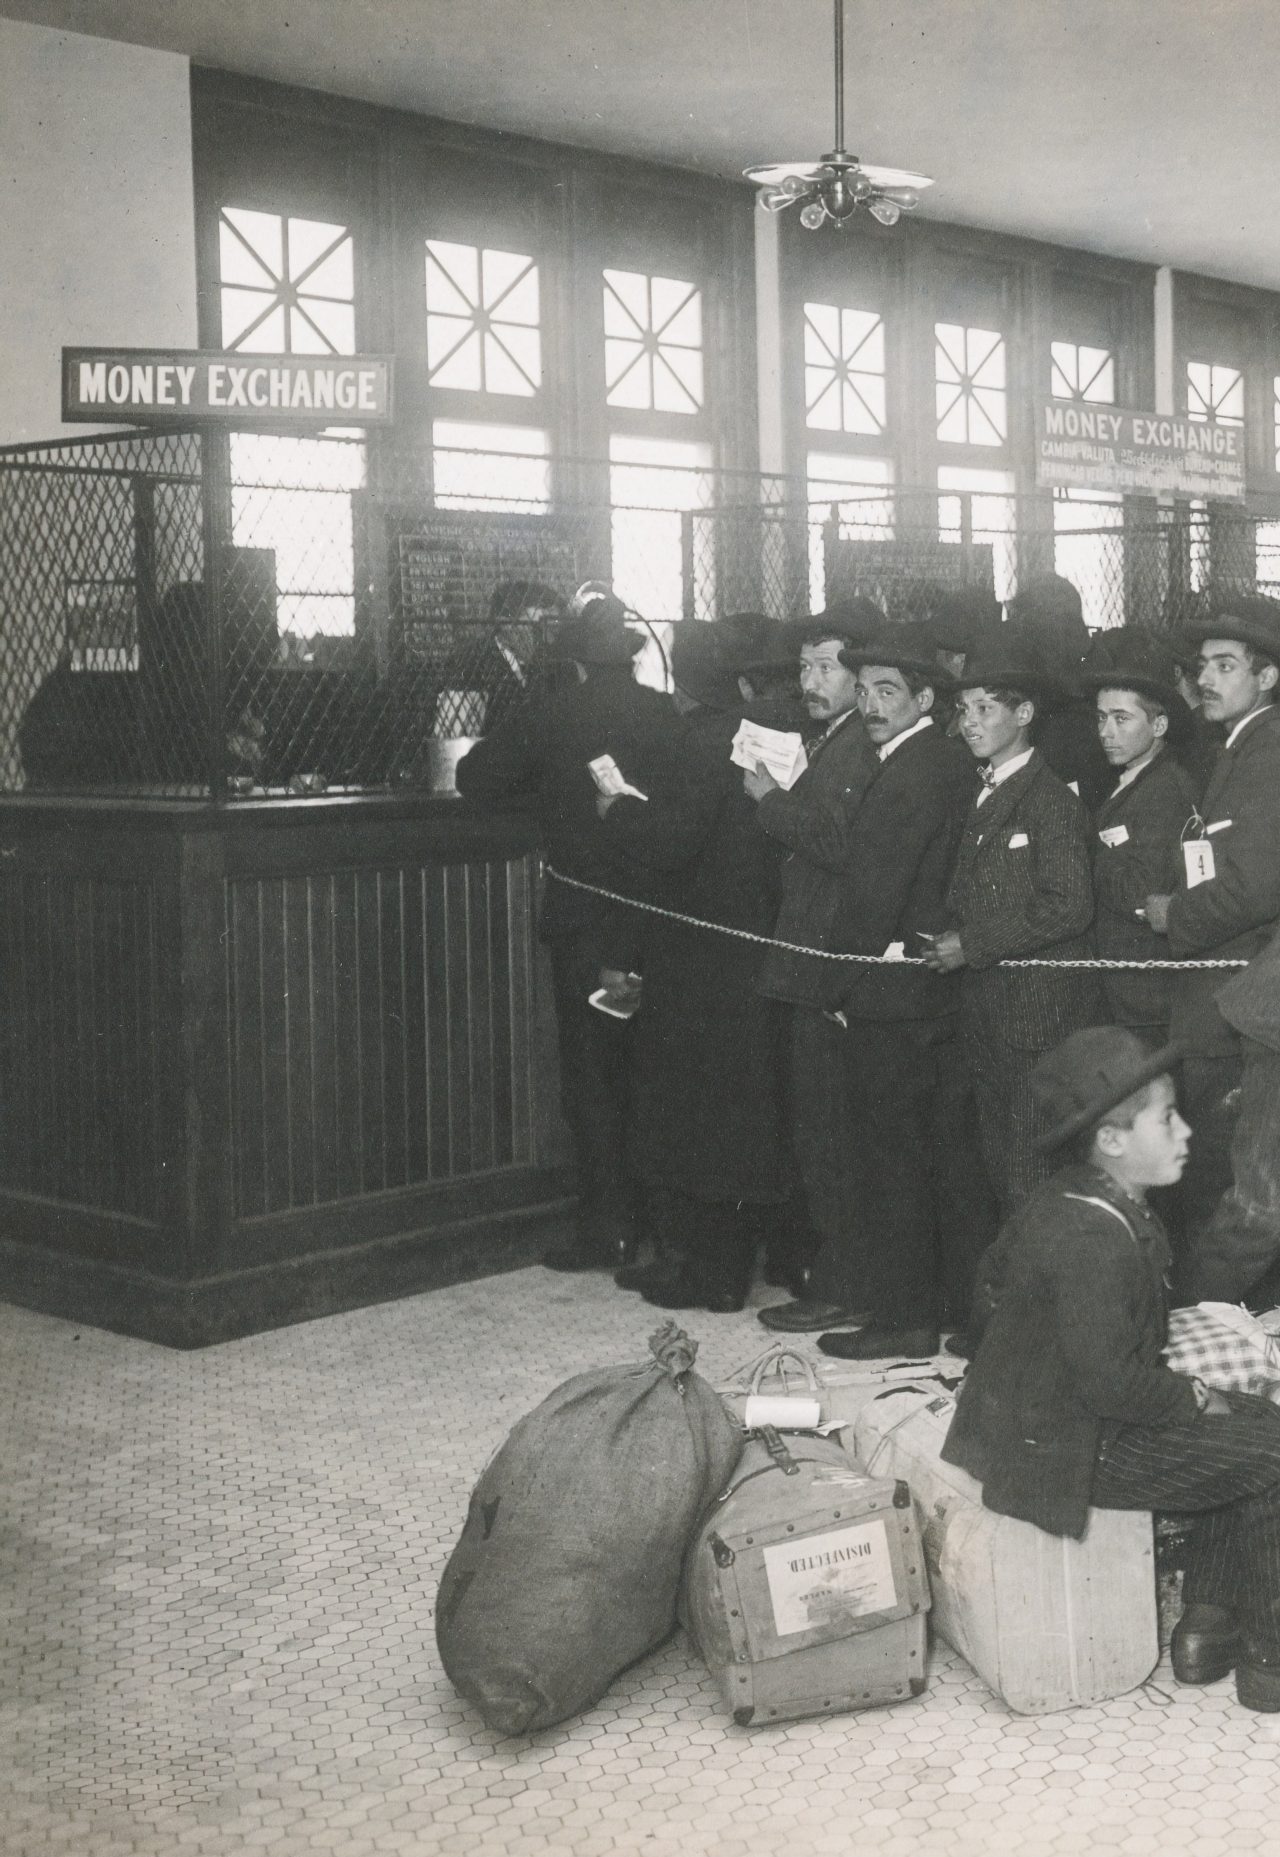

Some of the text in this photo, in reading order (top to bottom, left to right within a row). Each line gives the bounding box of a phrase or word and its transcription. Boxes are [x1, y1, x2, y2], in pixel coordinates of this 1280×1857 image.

[79, 361, 378, 411] MONEY EXCHANGE
[1045, 406, 1237, 456] MONEY EXCHANGE
[1198, 855, 1205, 875] 4
